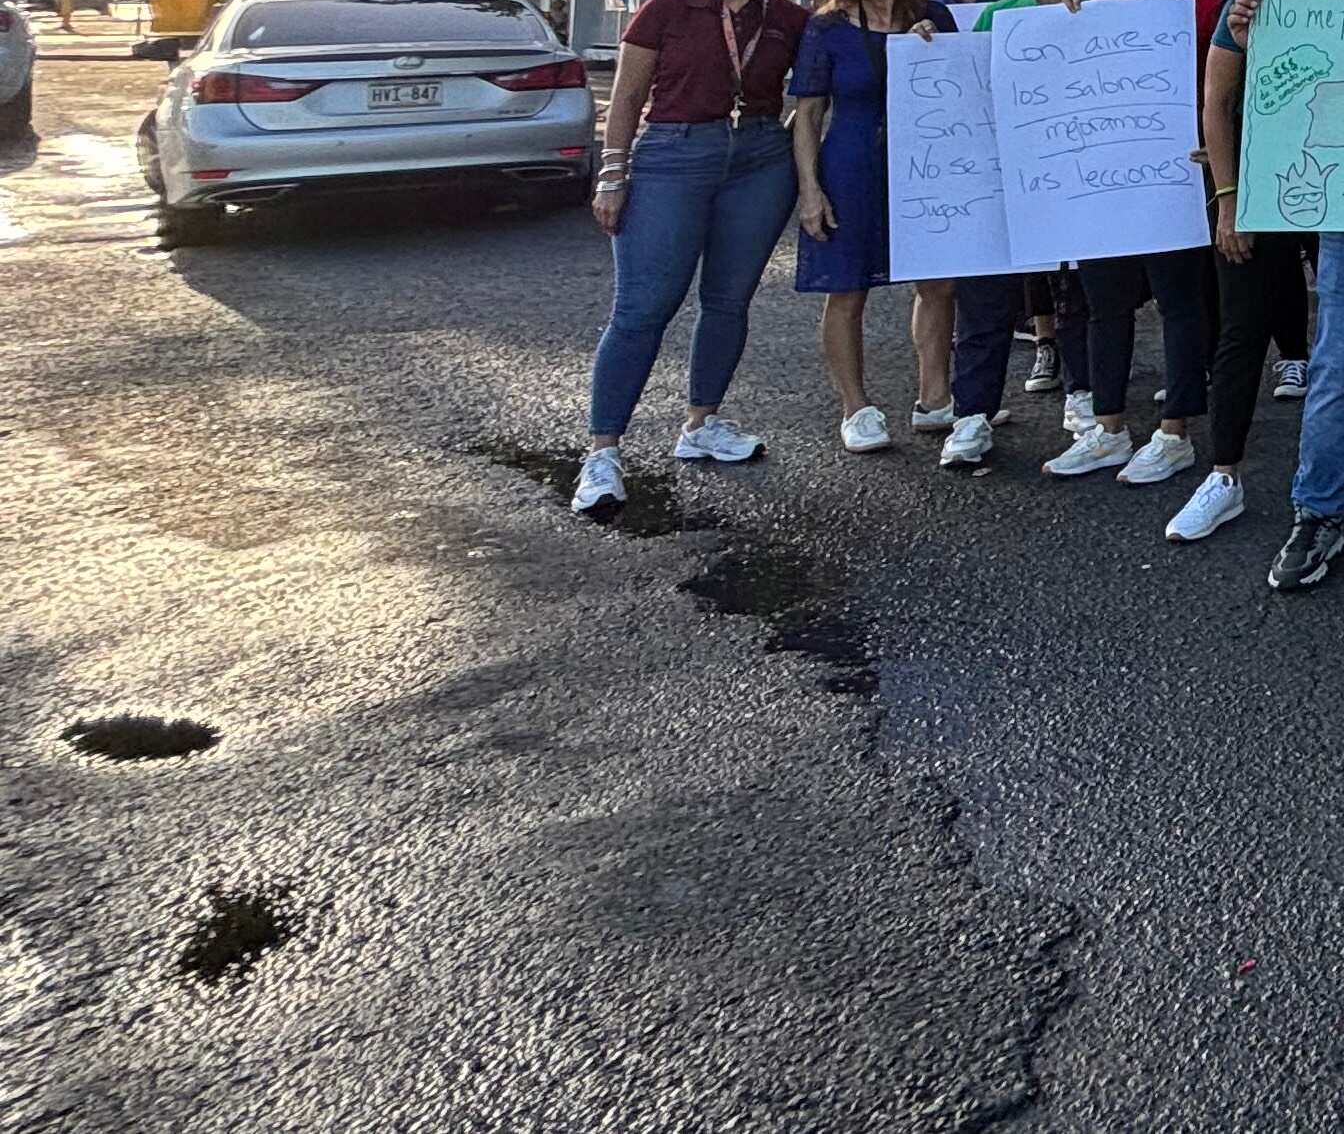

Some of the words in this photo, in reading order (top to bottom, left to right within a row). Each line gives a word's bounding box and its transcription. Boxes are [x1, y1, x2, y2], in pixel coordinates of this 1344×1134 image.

[1306, 10, 1336, 29] me
[1003, 19, 1066, 63] Con
[1084, 29, 1149, 56] aire
[1153, 30, 1192, 47] en
[371, 86, 439, 103] HVI-847
[908, 57, 962, 99] En
[1012, 81, 1050, 107] los
[1065, 68, 1180, 99] salones,
[915, 108, 973, 140] Sin
[1044, 111, 1168, 154] mejoramos
[908, 144, 941, 181] No
[1019, 167, 1062, 195] las
[1075, 157, 1192, 190] lecciones
[900, 195, 995, 234] Jugar
